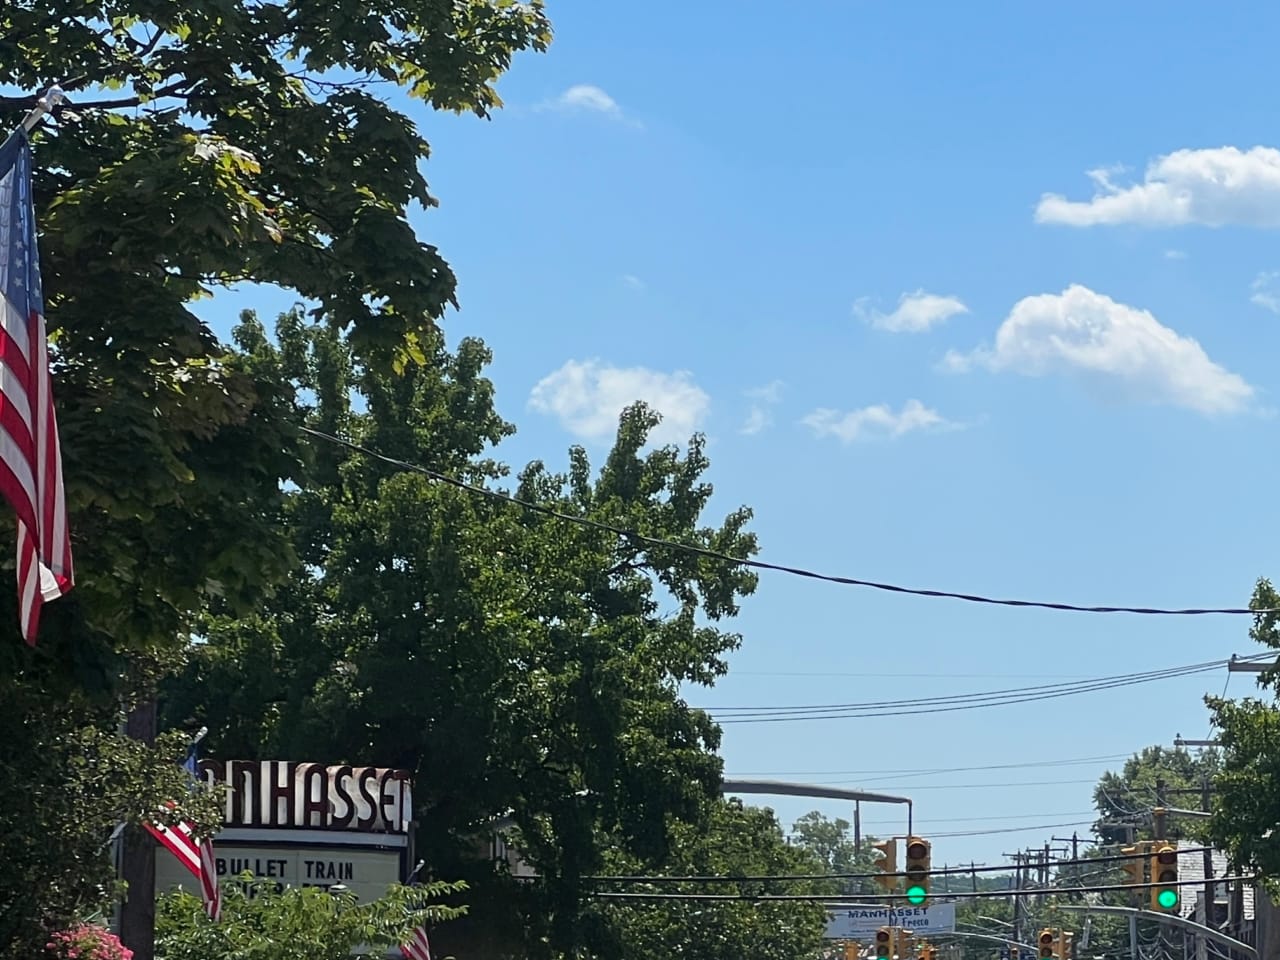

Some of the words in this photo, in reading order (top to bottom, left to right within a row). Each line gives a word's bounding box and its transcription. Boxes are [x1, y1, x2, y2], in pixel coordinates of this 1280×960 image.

[216, 859, 287, 877] BULLET
[304, 861, 353, 879] TRAIN
[848, 908, 928, 919] MANHASSET
